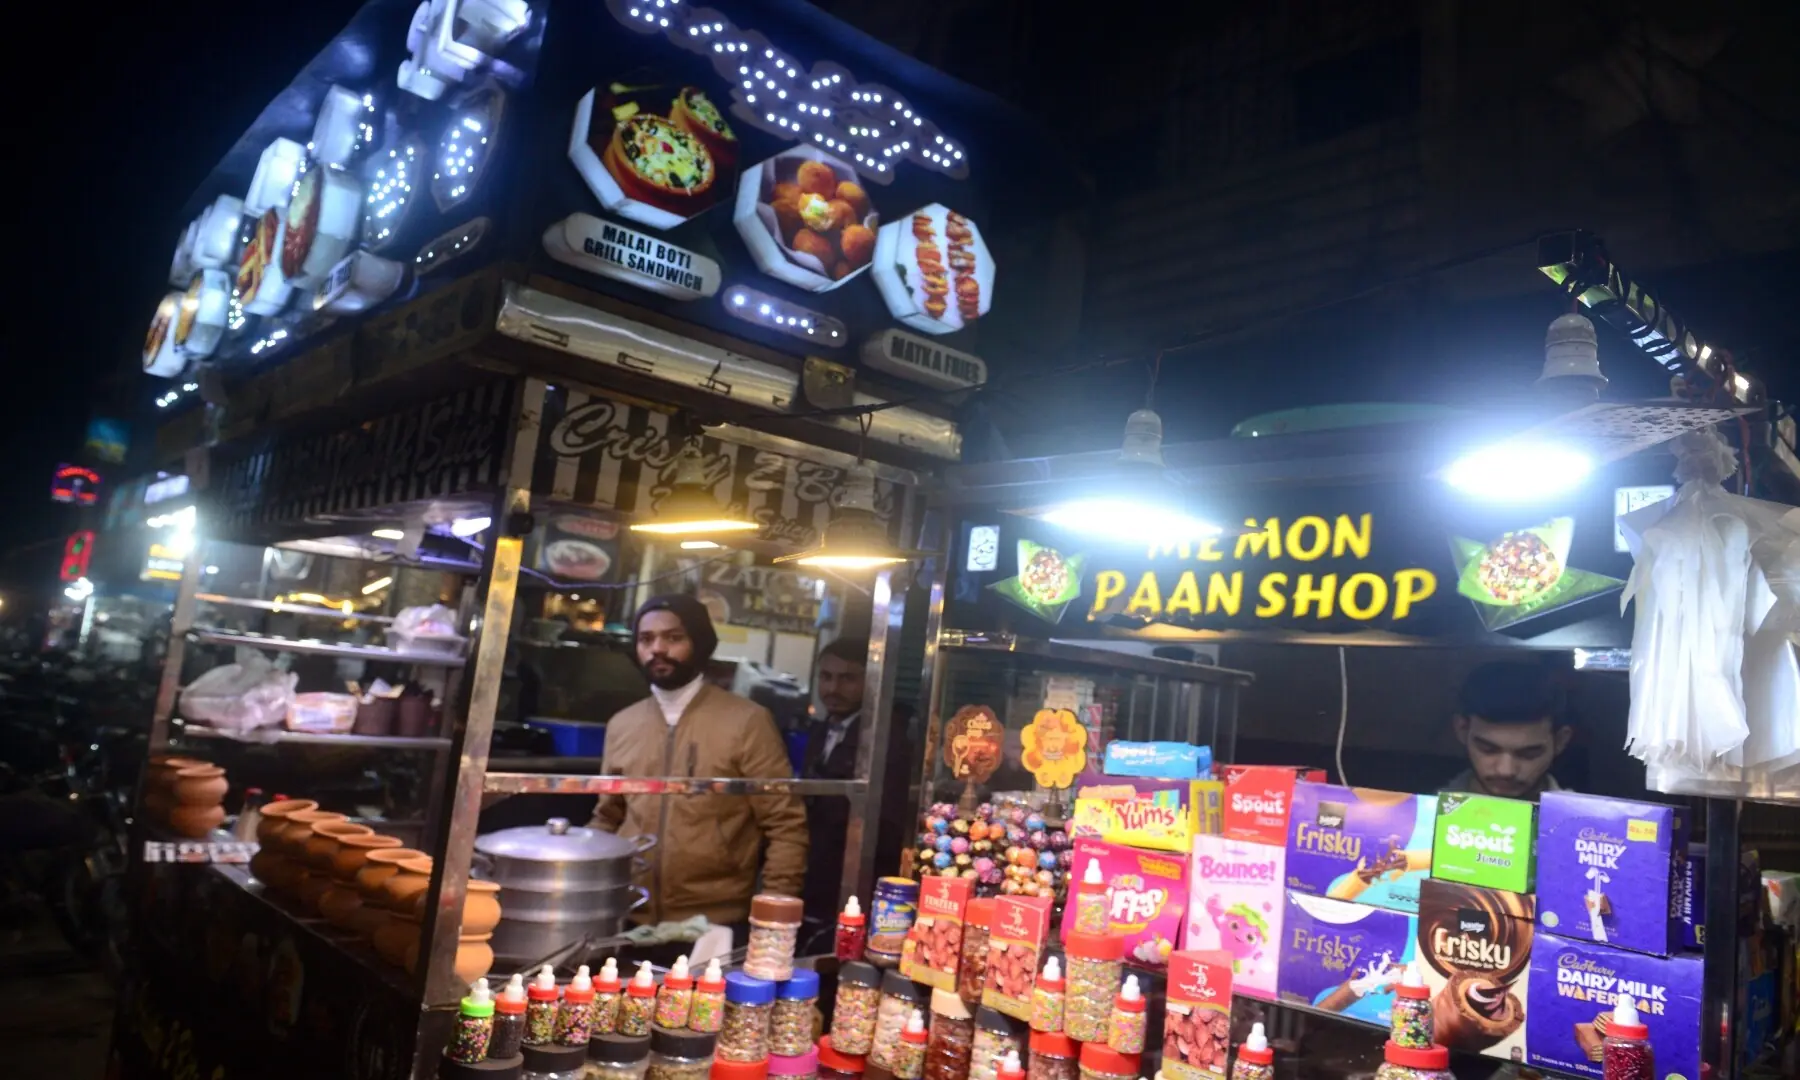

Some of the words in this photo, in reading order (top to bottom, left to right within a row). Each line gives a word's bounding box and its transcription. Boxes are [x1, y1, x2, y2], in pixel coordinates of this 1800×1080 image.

[602, 224, 652, 256] MALAI
[656, 243, 691, 269] BOTI
[583, 237, 624, 265] GRILL
[627, 252, 704, 291] SANDWICH
[1086, 570, 1244, 618] PAAN
[1254, 568, 1438, 621] SHOP
[1113, 801, 1175, 831] Yums
[1231, 792, 1286, 815] Spout
[1297, 822, 1361, 862] Frisky
[1446, 823, 1515, 855] Spout
[1575, 839, 1627, 859] DAIRY
[1578, 826, 1625, 845] Cadbury
[1198, 854, 1277, 882] Bounce!
[1578, 851, 1619, 871] MILK
[1434, 927, 1511, 970] Frisky
[1557, 953, 1616, 977] Cadbury
[1557, 968, 1618, 990] DAIRY
[1617, 979, 1668, 1001] MILK
[1557, 982, 1619, 1006] WAFER
